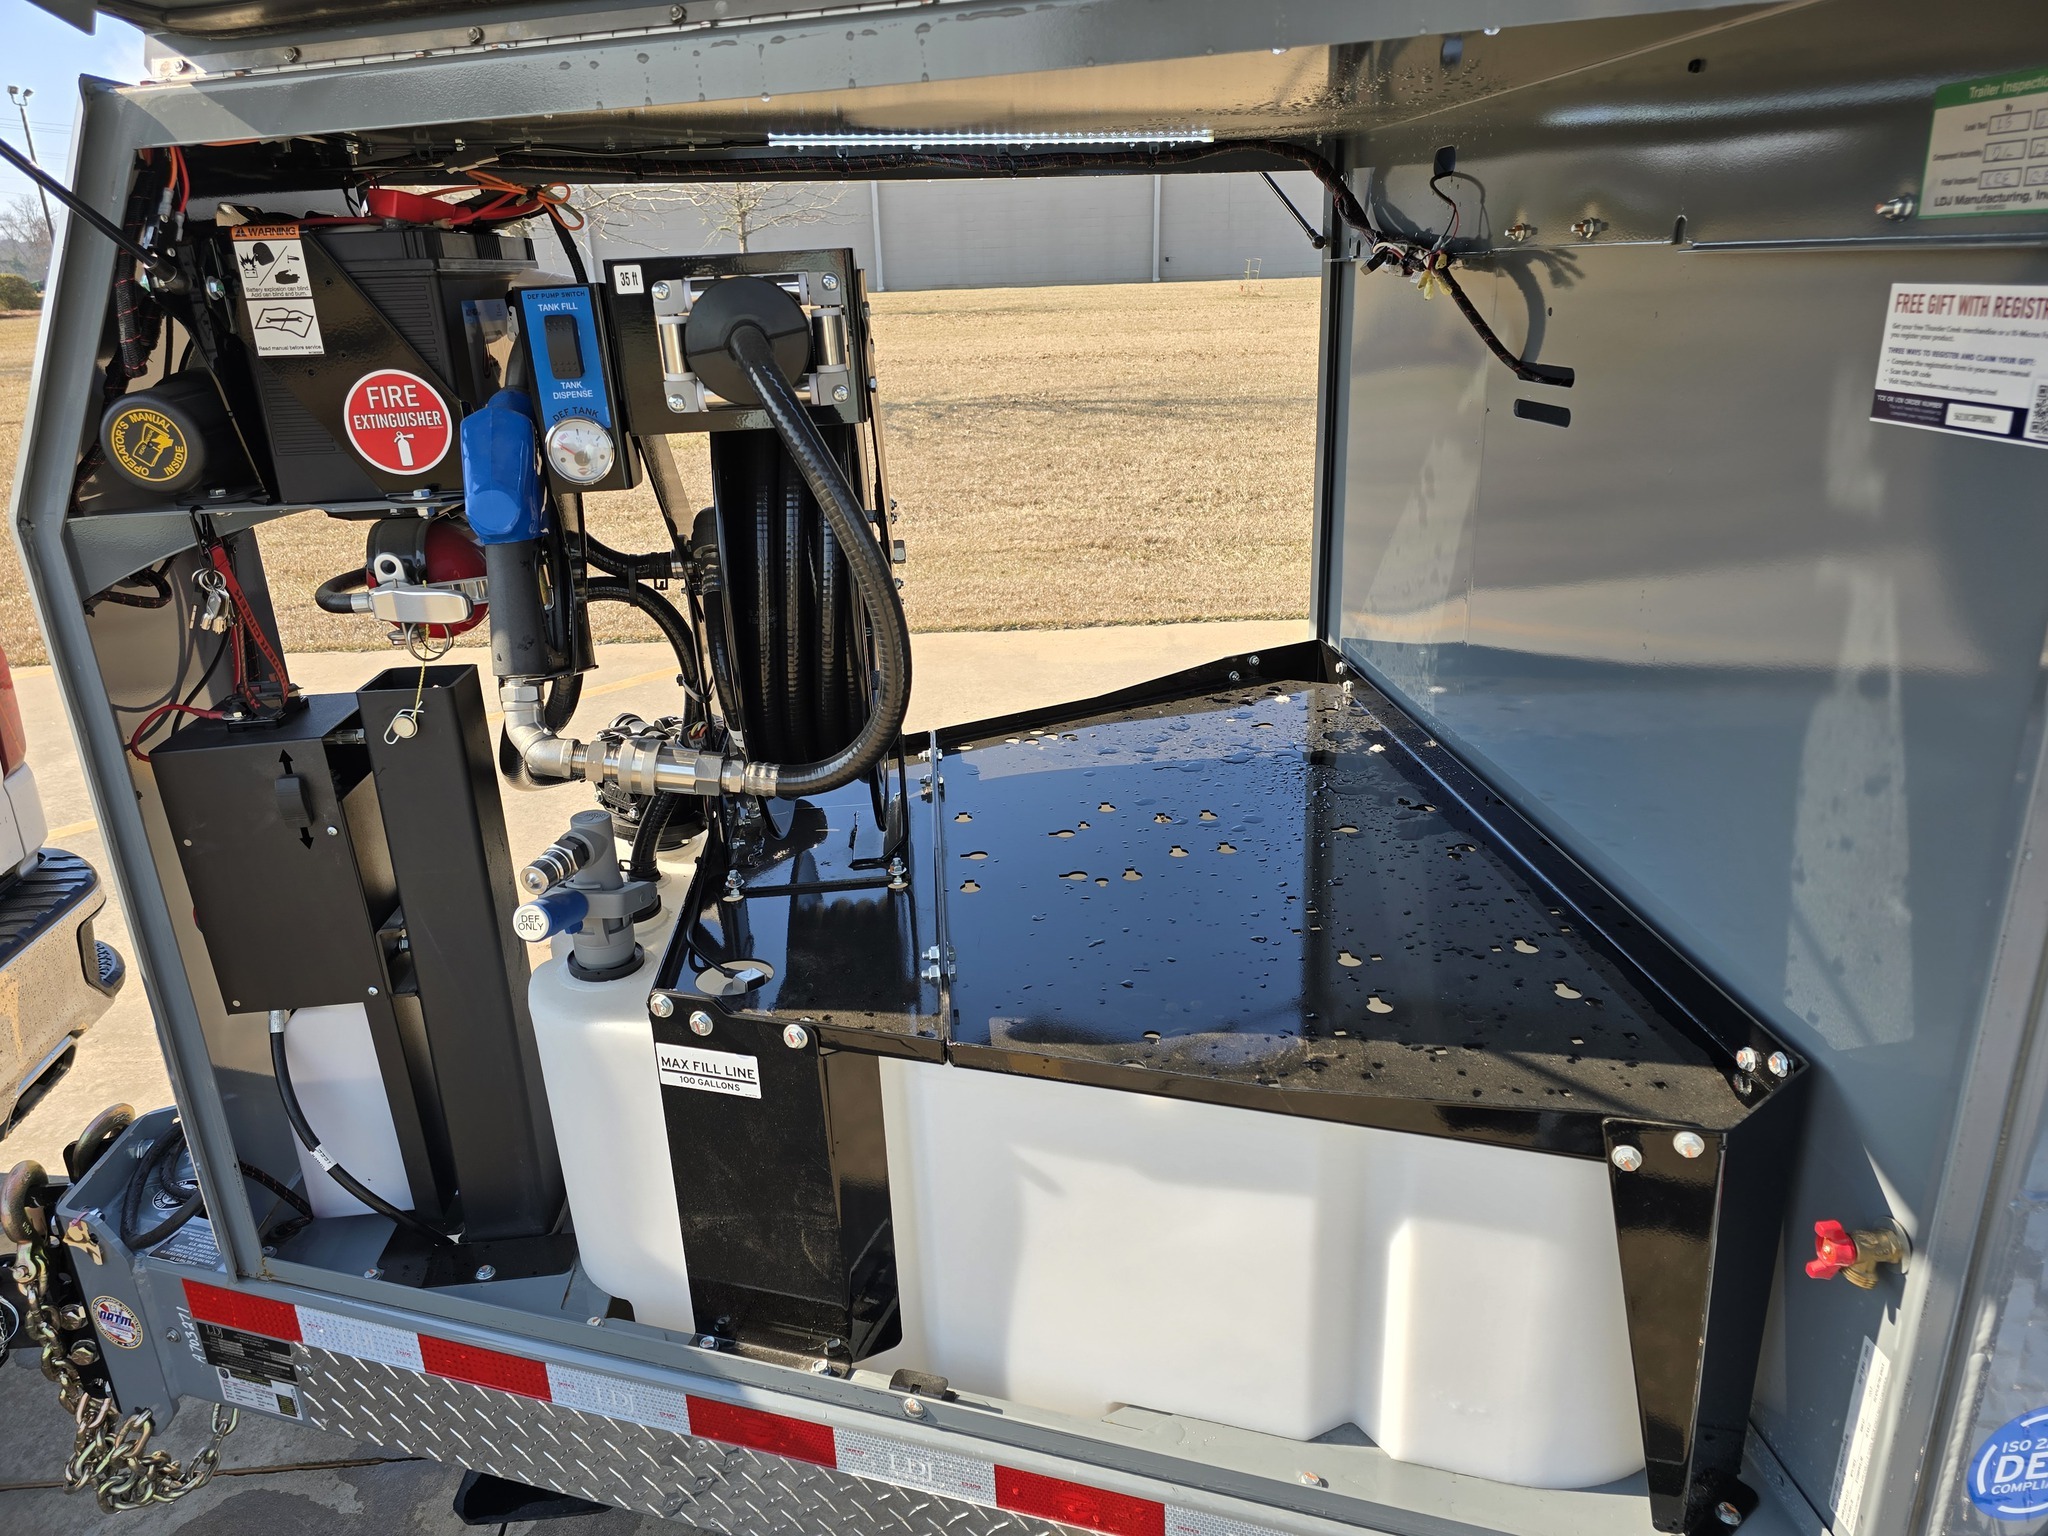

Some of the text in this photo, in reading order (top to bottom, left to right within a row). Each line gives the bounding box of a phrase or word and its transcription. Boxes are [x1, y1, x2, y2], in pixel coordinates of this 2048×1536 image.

[1969, 85, 2000, 98] Trailer
[1934, 197, 1952, 207] LDJ
[1955, 191, 2032, 206] Manufacturing,
[248, 226, 296, 237] WARNING
[620, 271, 639, 286] 35 ft
[538, 302, 578, 312] TANK FILL
[1894, 293, 1926, 314] FREE
[1927, 294, 1956, 316] GIFT
[1957, 295, 1991, 317] WITH
[1932, 351, 1959, 360] REGISTER
[560, 381, 583, 390] TANK
[366, 384, 420, 409] FIRE
[553, 390, 594, 400] DISPENSE
[353, 411, 442, 430] EXTINGUISHER
[552, 407, 569, 422] DEF
[572, 406, 599, 418] TANK
[115, 412, 184, 476] OPERATOR'S MANUAL INSIDE
[518, 922, 544, 931] ONLY
[521, 914, 540, 923] DEF
[661, 1056, 756, 1079] MAX FILL LINE
[679, 1075, 741, 1092] 100 GALLONS
[176, 1306, 208, 1364] A703271
[206, 1325, 224, 1339] LDJ
[595, 1386, 634, 1413] LDJ
[2002, 1438, 2048, 1453] ISO 2
[889, 1454, 934, 1483] LDJ
[1994, 1451, 2048, 1483] DE
